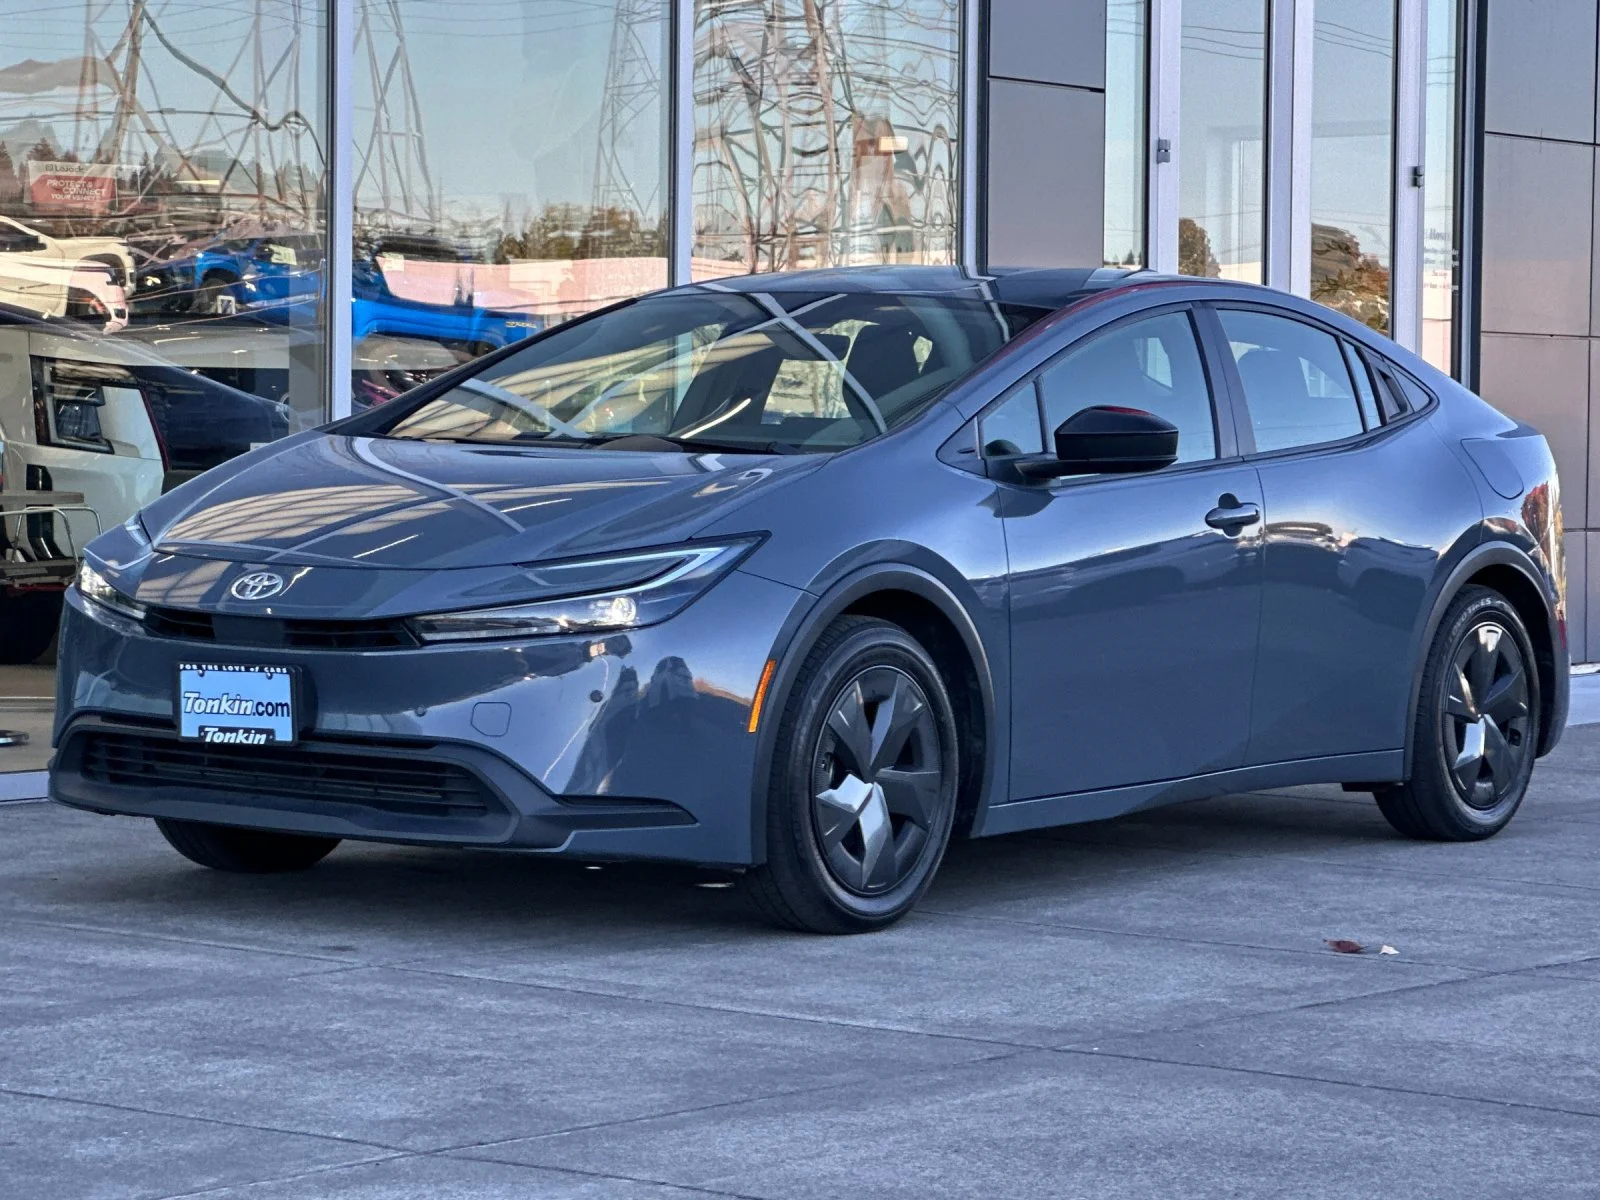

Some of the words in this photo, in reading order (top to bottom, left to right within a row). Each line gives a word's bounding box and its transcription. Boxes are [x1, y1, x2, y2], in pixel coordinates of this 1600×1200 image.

[62, 187, 106, 197] CONNECT
[180, 663, 198, 671] FOR
[183, 691, 290, 717] Tonkin.com
[204, 727, 267, 745] Tonkin
